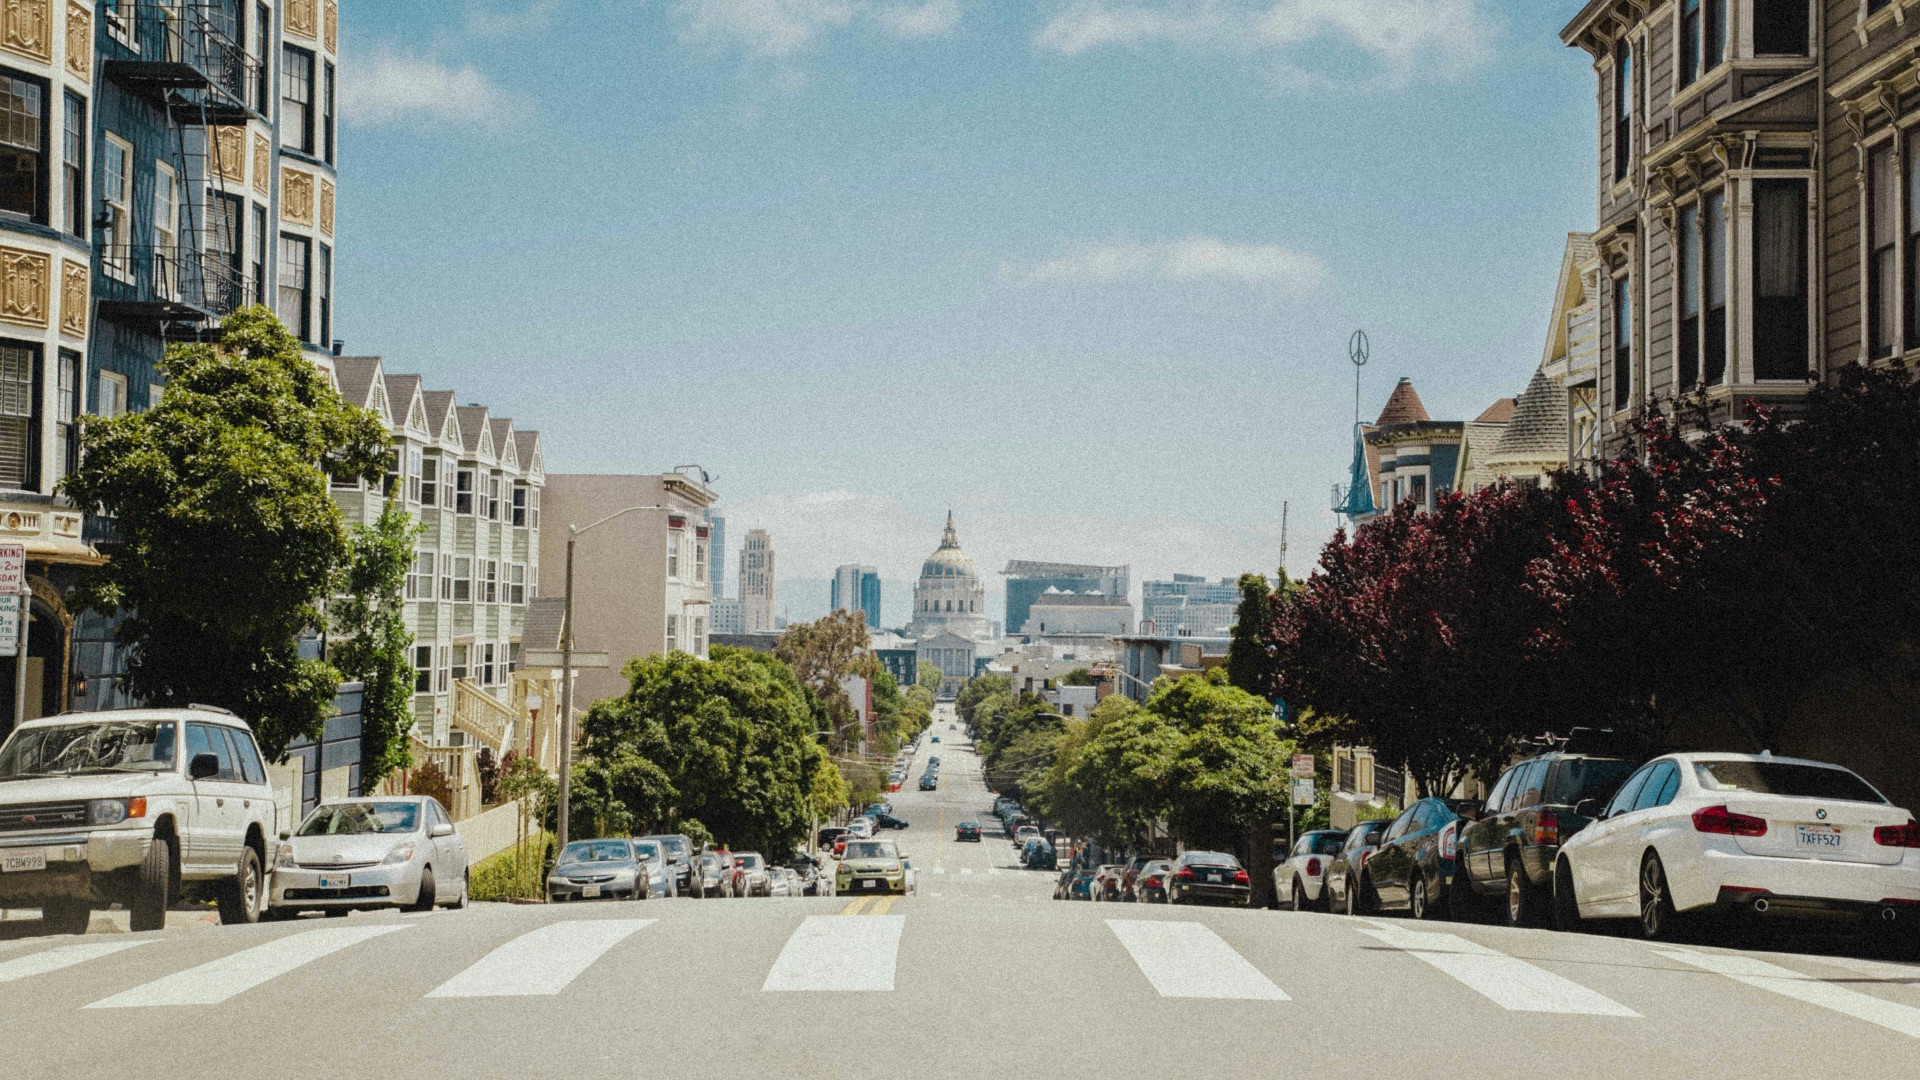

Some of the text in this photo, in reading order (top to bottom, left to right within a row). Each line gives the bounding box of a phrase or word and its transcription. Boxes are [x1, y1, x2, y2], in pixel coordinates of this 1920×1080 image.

[0, 574, 17, 582] DAY
[1800, 833, 1841, 846] 7XFF527
[5, 856, 43, 868] 7CBW998
